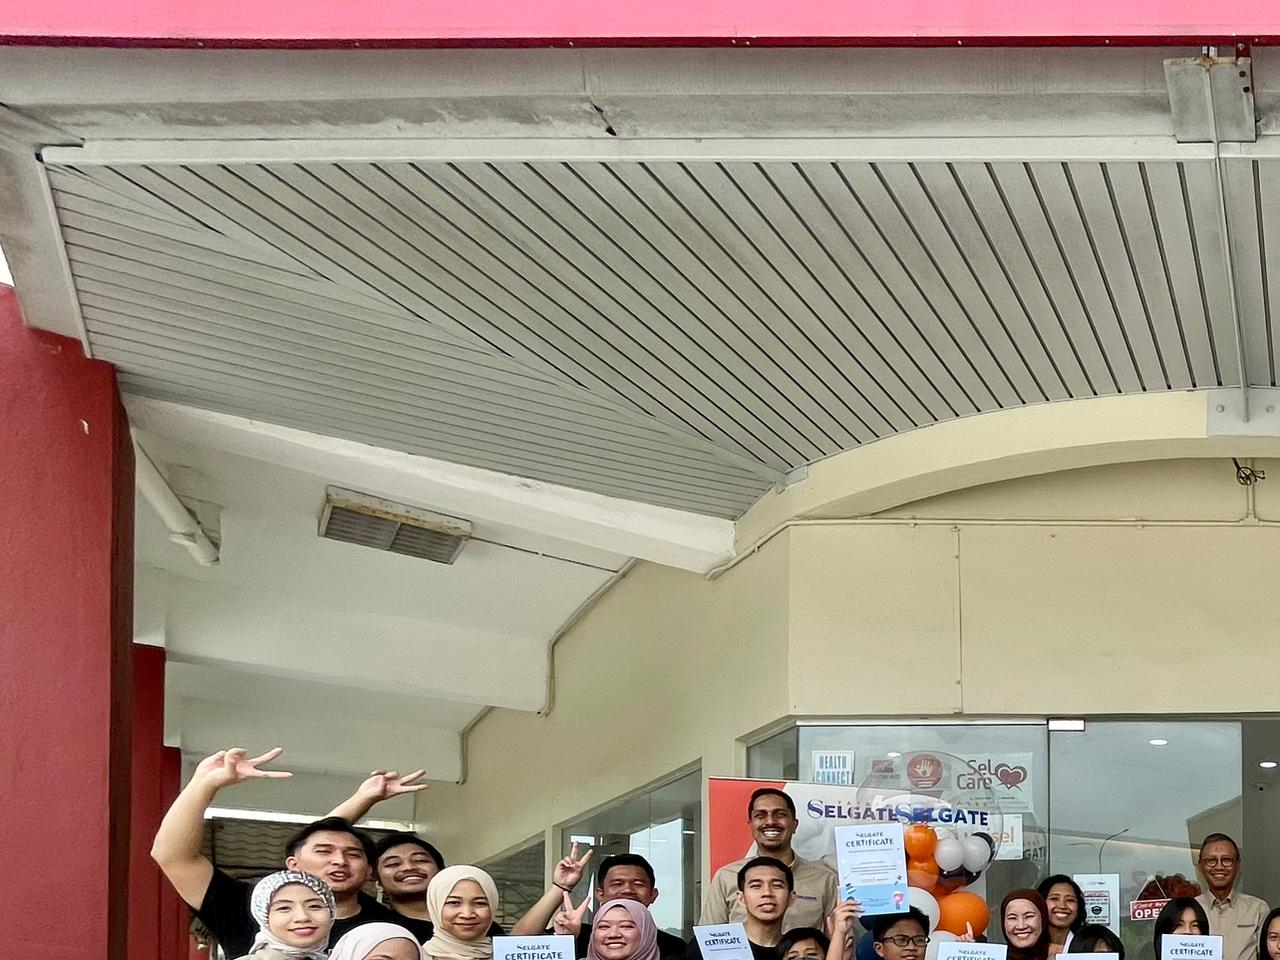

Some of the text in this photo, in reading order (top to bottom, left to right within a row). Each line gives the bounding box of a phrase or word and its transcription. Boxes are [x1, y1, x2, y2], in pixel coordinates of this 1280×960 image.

[967, 758, 997, 776] Sel
[957, 773, 993, 791] Care
[846, 837, 894, 847] CERTIFICATE
[1135, 908, 1161, 919] OPE
[705, 937, 741, 945] CERTIFICATE
[505, 951, 562, 960] CERTIFICATE
[1170, 948, 1213, 956] CERTIFICATE
